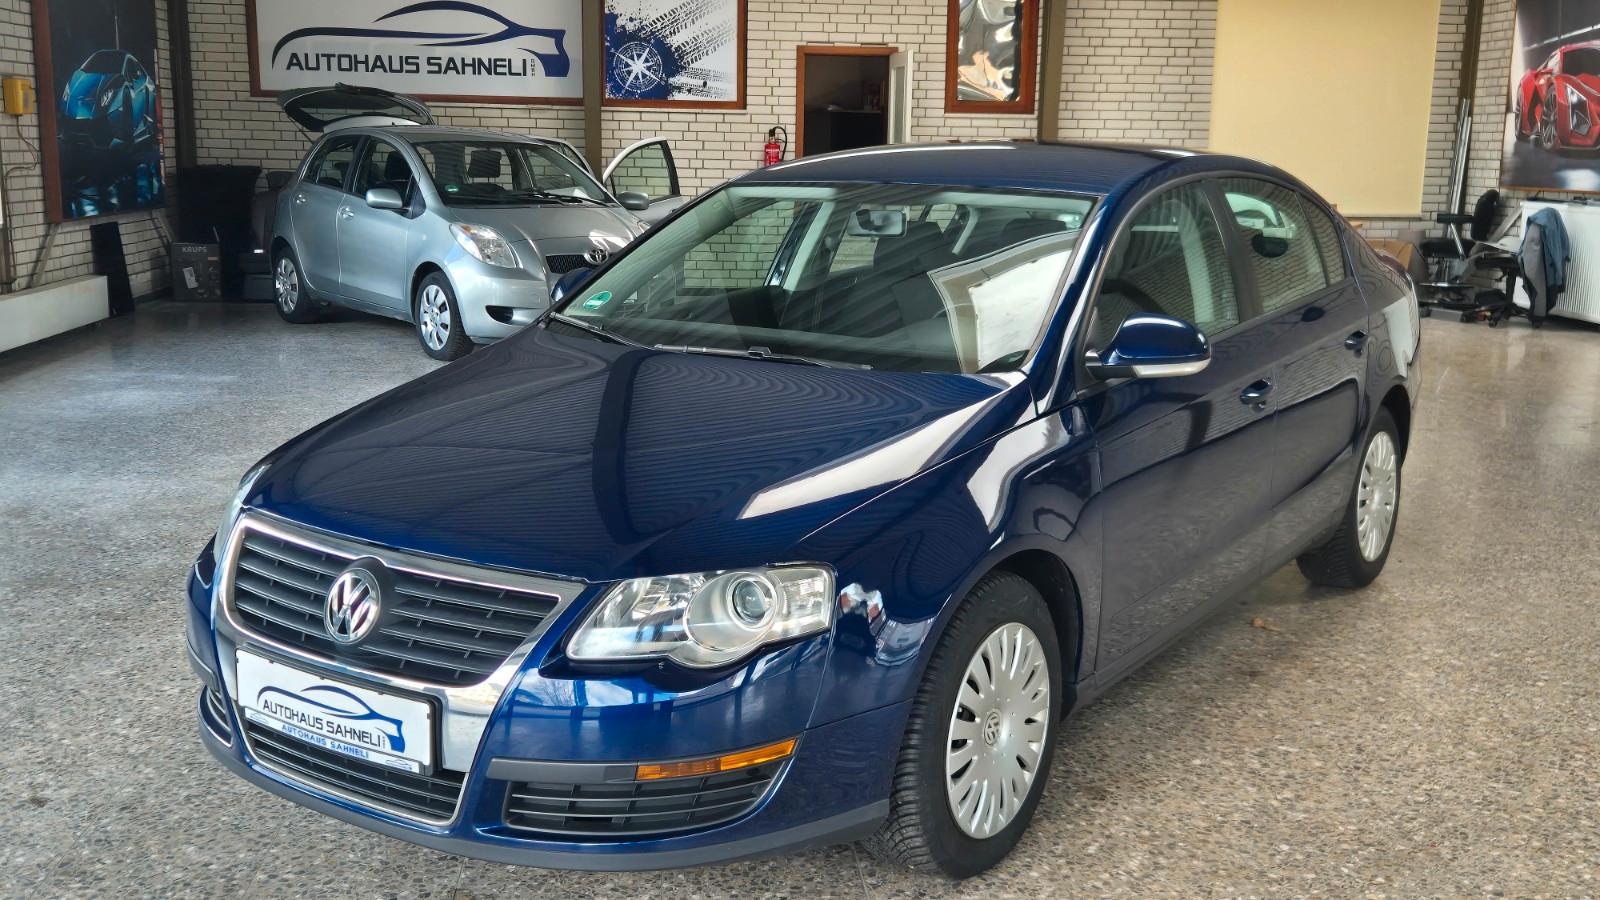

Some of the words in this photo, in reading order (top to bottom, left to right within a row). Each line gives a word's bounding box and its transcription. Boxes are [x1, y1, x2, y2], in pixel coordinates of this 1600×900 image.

[285, 52, 420, 74] AUTOHAUS
[426, 56, 527, 77] SAHNELI
[262, 699, 323, 731] AUTOHAUS
[326, 721, 381, 747] SAHNELI
[281, 724, 328, 746] AUTOHAUS
[330, 741, 369, 759] SAHNELI
